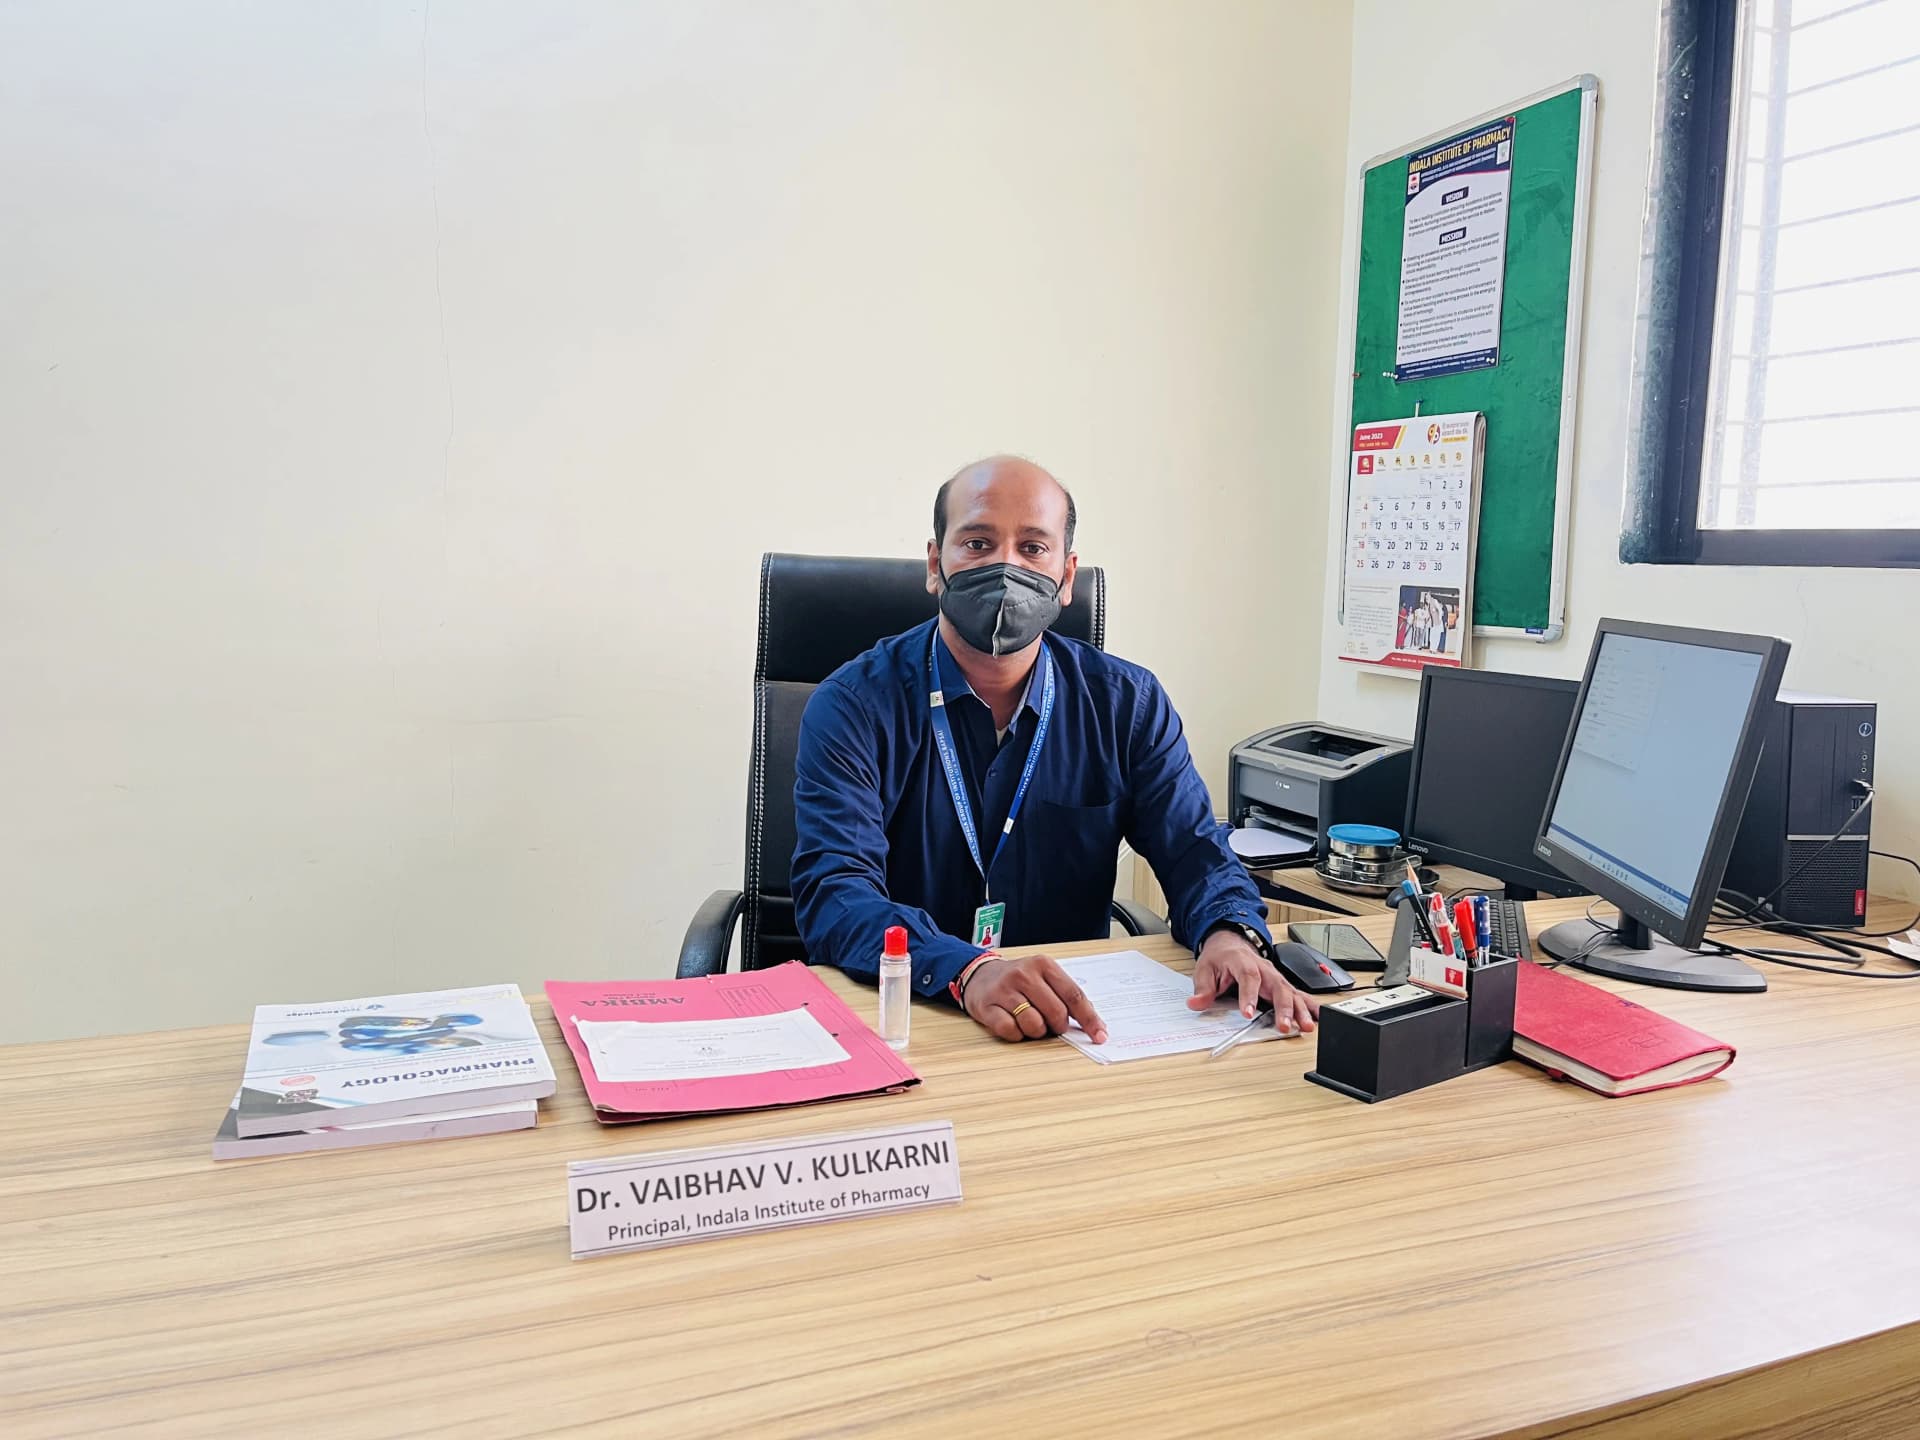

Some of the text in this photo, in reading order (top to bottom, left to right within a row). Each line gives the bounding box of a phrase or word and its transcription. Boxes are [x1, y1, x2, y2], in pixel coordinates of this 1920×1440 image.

[1409, 157, 1431, 173] INDALA
[1432, 147, 1462, 166] INSTITUTE
[1463, 142, 1470, 154] OF
[1472, 127, 1511, 151] PHARMACY
[1445, 191, 1463, 203] VISION
[1441, 230, 1464, 244] MISSION
[1428, 480, 1463, 490] 1 2 3
[1380, 502, 1384, 510] 5
[1394, 502, 1399, 510] 6
[1411, 502, 1416, 510] 7
[1426, 502, 1430, 510] 8
[1442, 501, 1446, 510] 9
[1454, 501, 1462, 510] 10
[1375, 522, 1382, 530] 12
[1391, 522, 1397, 530] 13
[1406, 522, 1412, 530] 14
[1422, 522, 1429, 530] 15
[1438, 522, 1445, 530] 16
[1454, 522, 1460, 530] 17
[1358, 541, 1459, 550] 18 19 20 21 22 23 24
[1356, 560, 1442, 571] 25 26 27 28 29 30
[1408, 841, 1428, 854] Lenovo
[1538, 842, 1552, 856] Lenovo
[579, 997, 685, 1008] AMBIKA
[341, 1057, 535, 1088] PHARMACOLOGY
[576, 1140, 950, 1213] Dr. VAIBHAV V. KULKARNI
[608, 1184, 930, 1241] Principal, Indala Institute of Pharmacy
